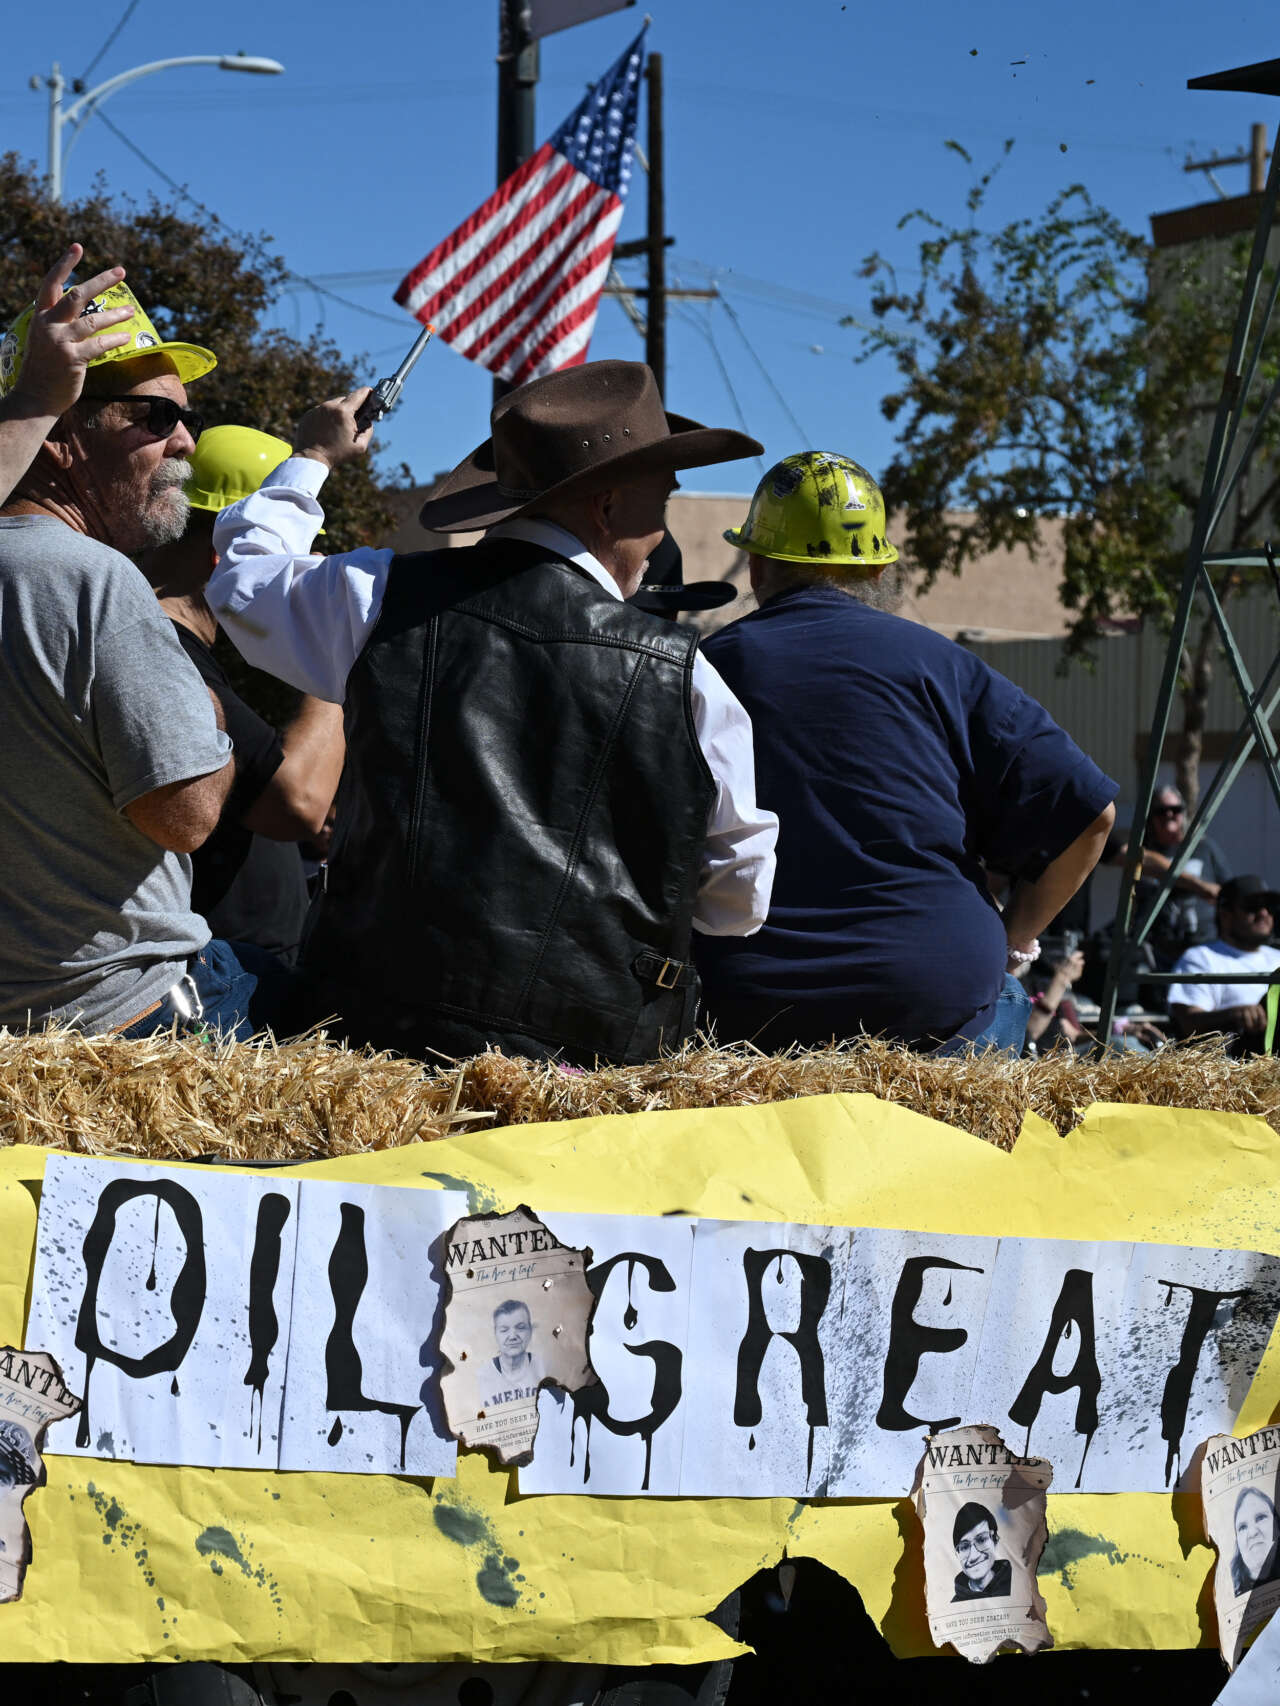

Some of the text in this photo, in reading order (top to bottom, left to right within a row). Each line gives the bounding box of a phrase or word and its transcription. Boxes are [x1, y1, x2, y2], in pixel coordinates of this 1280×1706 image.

[447, 1228, 561, 1268] WANTE
[75, 1178, 423, 1470] OIL
[582, 1246, 1248, 1490] GREAT
[1206, 1429, 1280, 1475] WANTE
